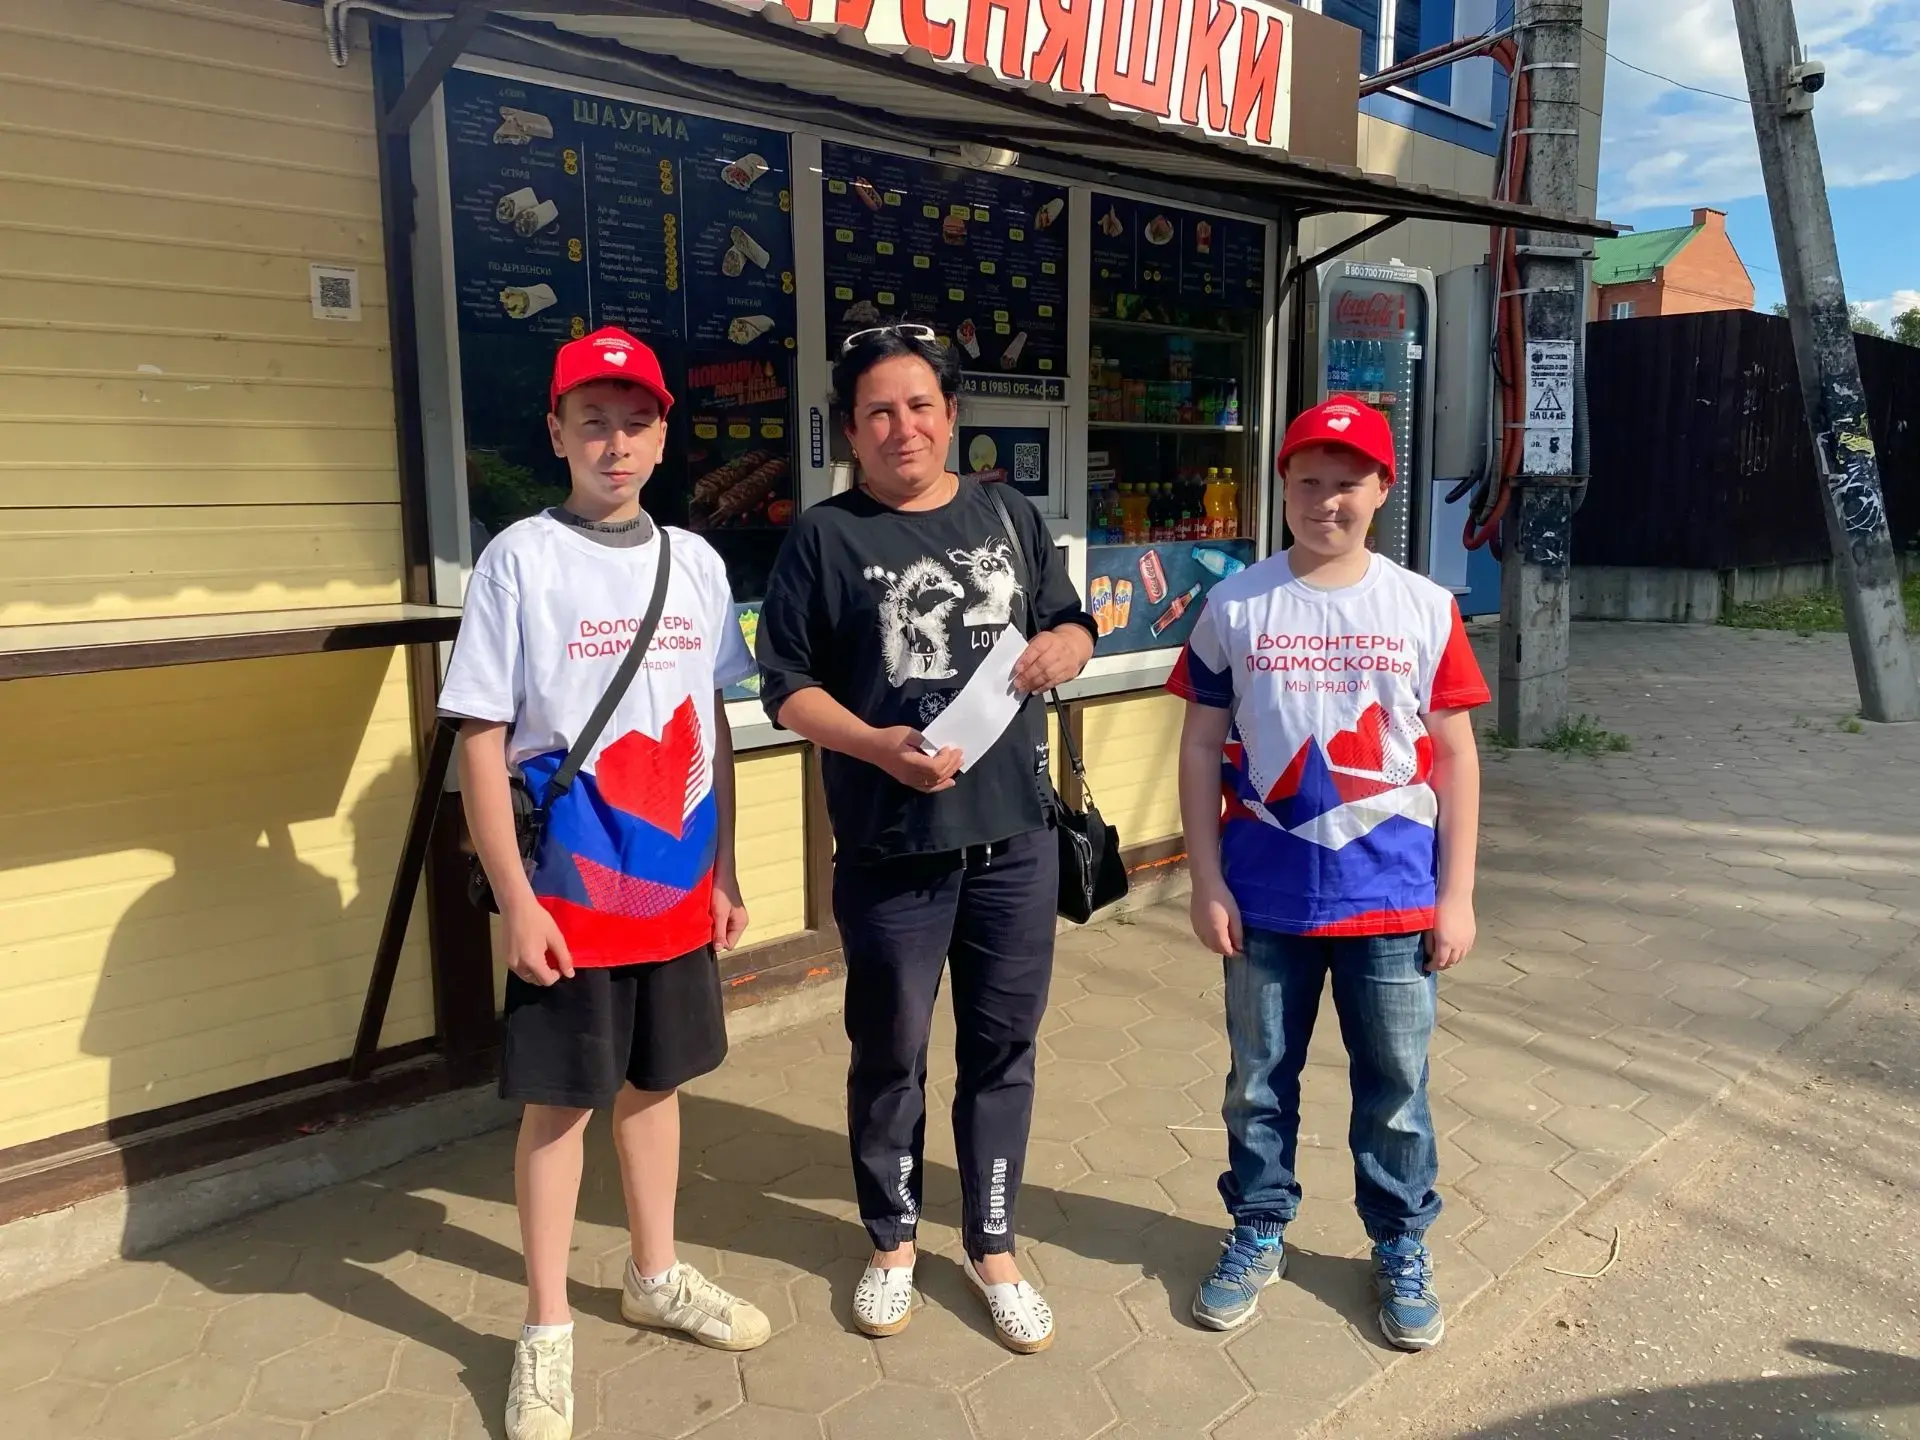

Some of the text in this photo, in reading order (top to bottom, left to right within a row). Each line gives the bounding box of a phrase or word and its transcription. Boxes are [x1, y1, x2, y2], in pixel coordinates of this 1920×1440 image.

[573, 99, 690, 142] ШАУРМА
[487, 261, 553, 276] ПО-ДЕРЕВЕНСКИ
[580, 616, 693, 638] ВОЛОЕРЫ
[568, 636, 701, 660] ПОДМСКОВЬЯ
[1257, 633, 1405, 653] ВОЛОНТЕРЫ
[1246, 655, 1412, 677] ПОДМОСКОВЬЯ
[1285, 680, 1370, 694] МЫ РЯДОМ
